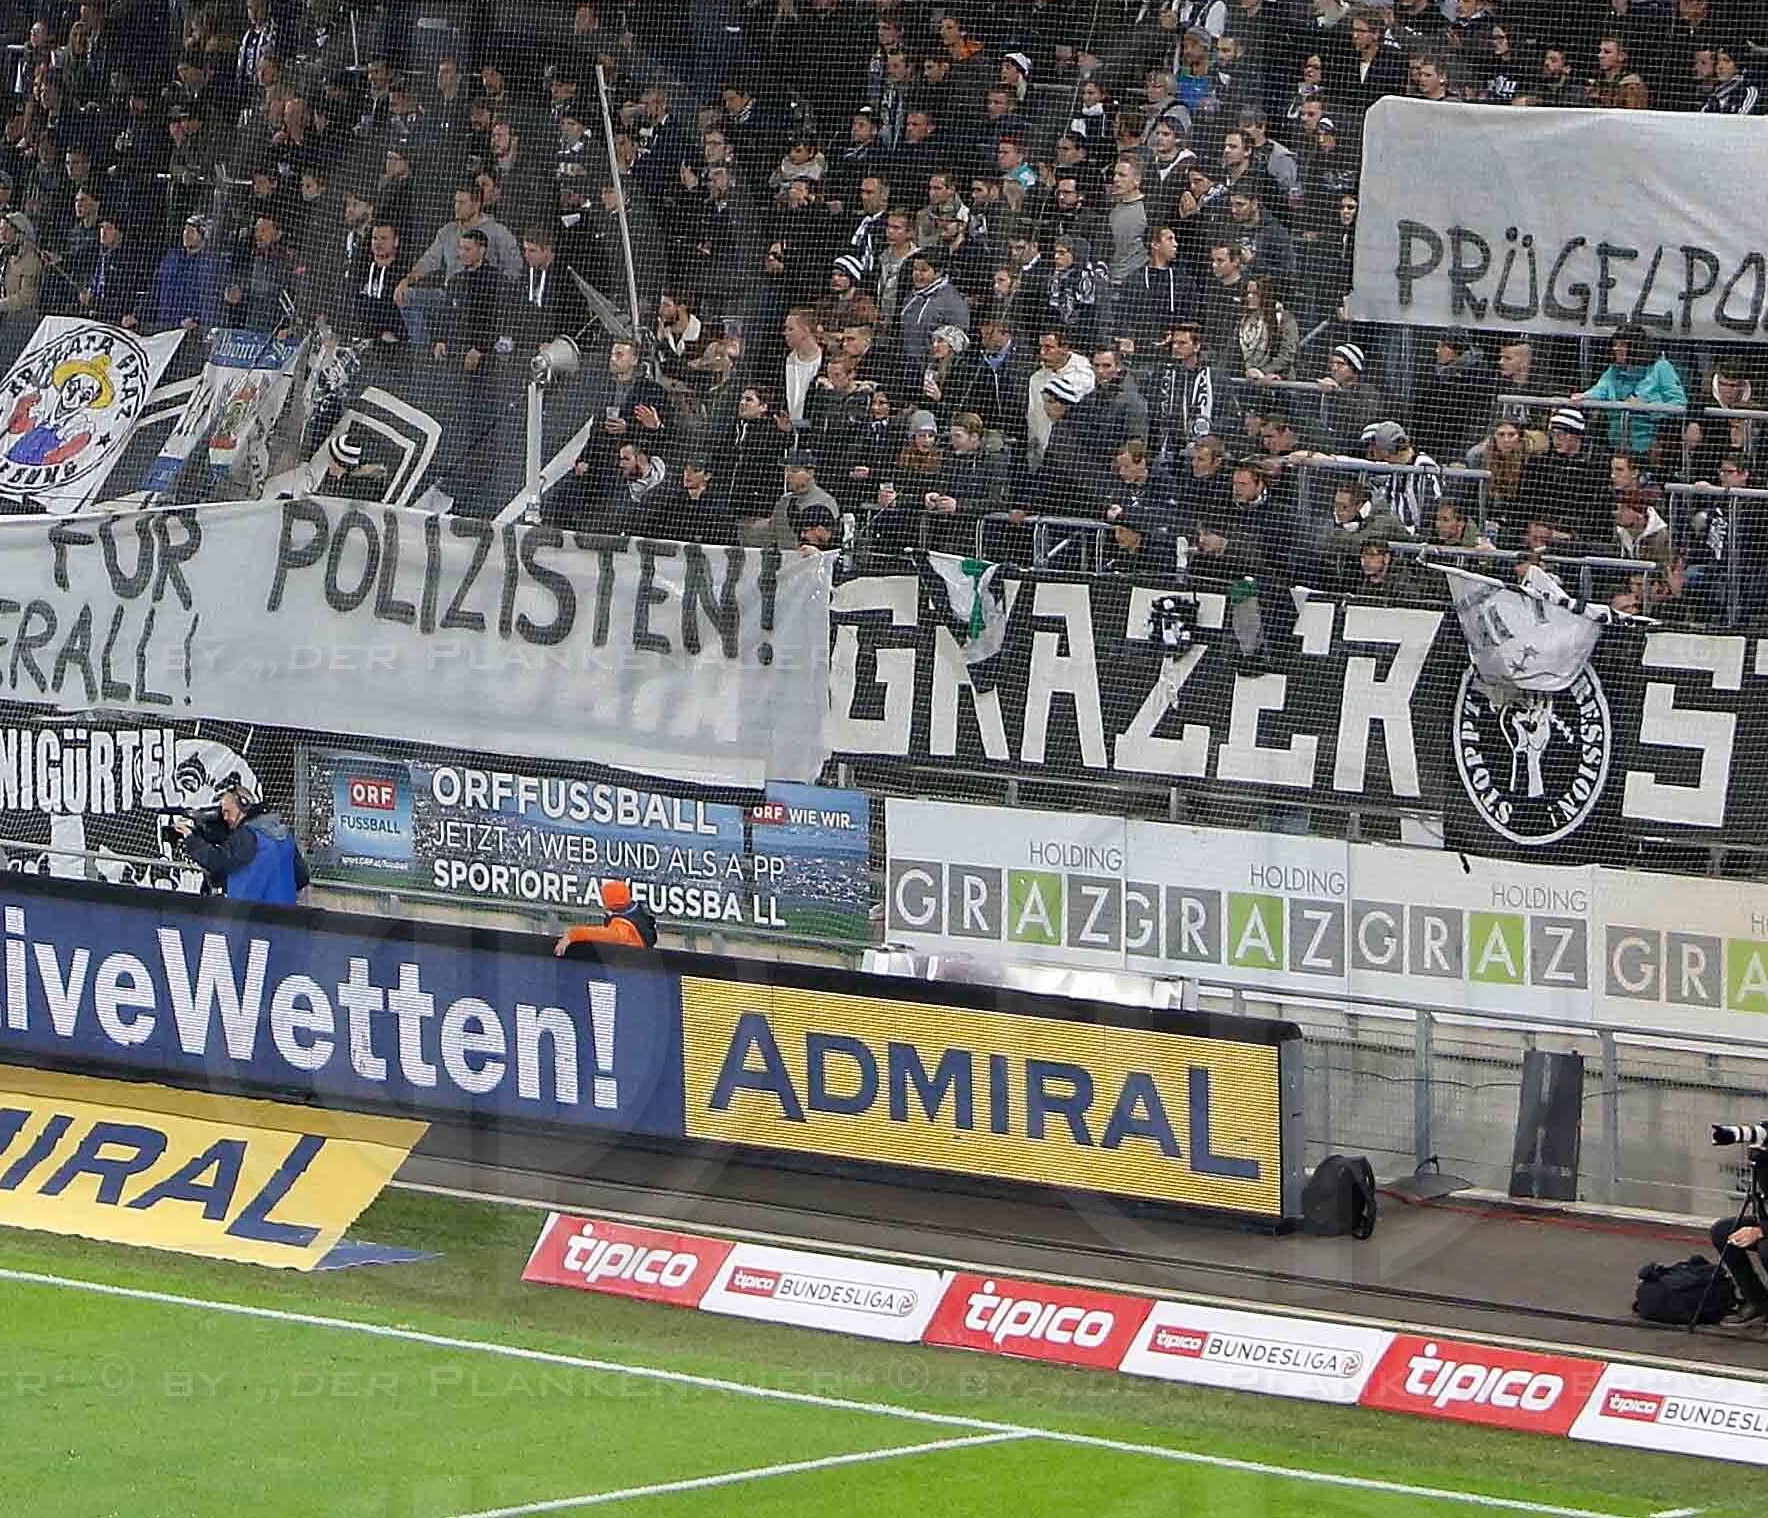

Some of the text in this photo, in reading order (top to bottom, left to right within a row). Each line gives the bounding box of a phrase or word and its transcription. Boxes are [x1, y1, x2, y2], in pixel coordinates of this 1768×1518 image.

[267, 497, 779, 667] POLIZISTEN!
[830, 575, 1446, 799] GRAZER
[352, 784, 393, 806] ORF
[753, 804, 784, 823] ORF
[789, 807, 820, 826] WIE
[339, 814, 401, 835] FUSSBALL
[431, 820, 507, 852] JETZT
[537, 832, 599, 865] WEB
[605, 840, 661, 872] UND
[667, 847, 718, 878] ALS
[1029, 842, 1124, 875] HOLDING
[1249, 862, 1346, 895] HOLDING
[894, 868, 1110, 947] GRAZ
[1491, 883, 1589, 913] HOLDING
[1126, 887, 1336, 969] GRAZ
[1355, 906, 1575, 981] GRAZ
[708, 1009, 1261, 1181] ADMIRAL
[562, 1222, 700, 1288] tipico
[733, 1267, 898, 1312] tipico BUNDESLIGA
[964, 1279, 1115, 1350] tipico
[1154, 1327, 1341, 1373] tipico BUNDESLIGA
[1404, 1343, 1566, 1414] tipico
[1605, 1391, 1660, 1422] tipico
